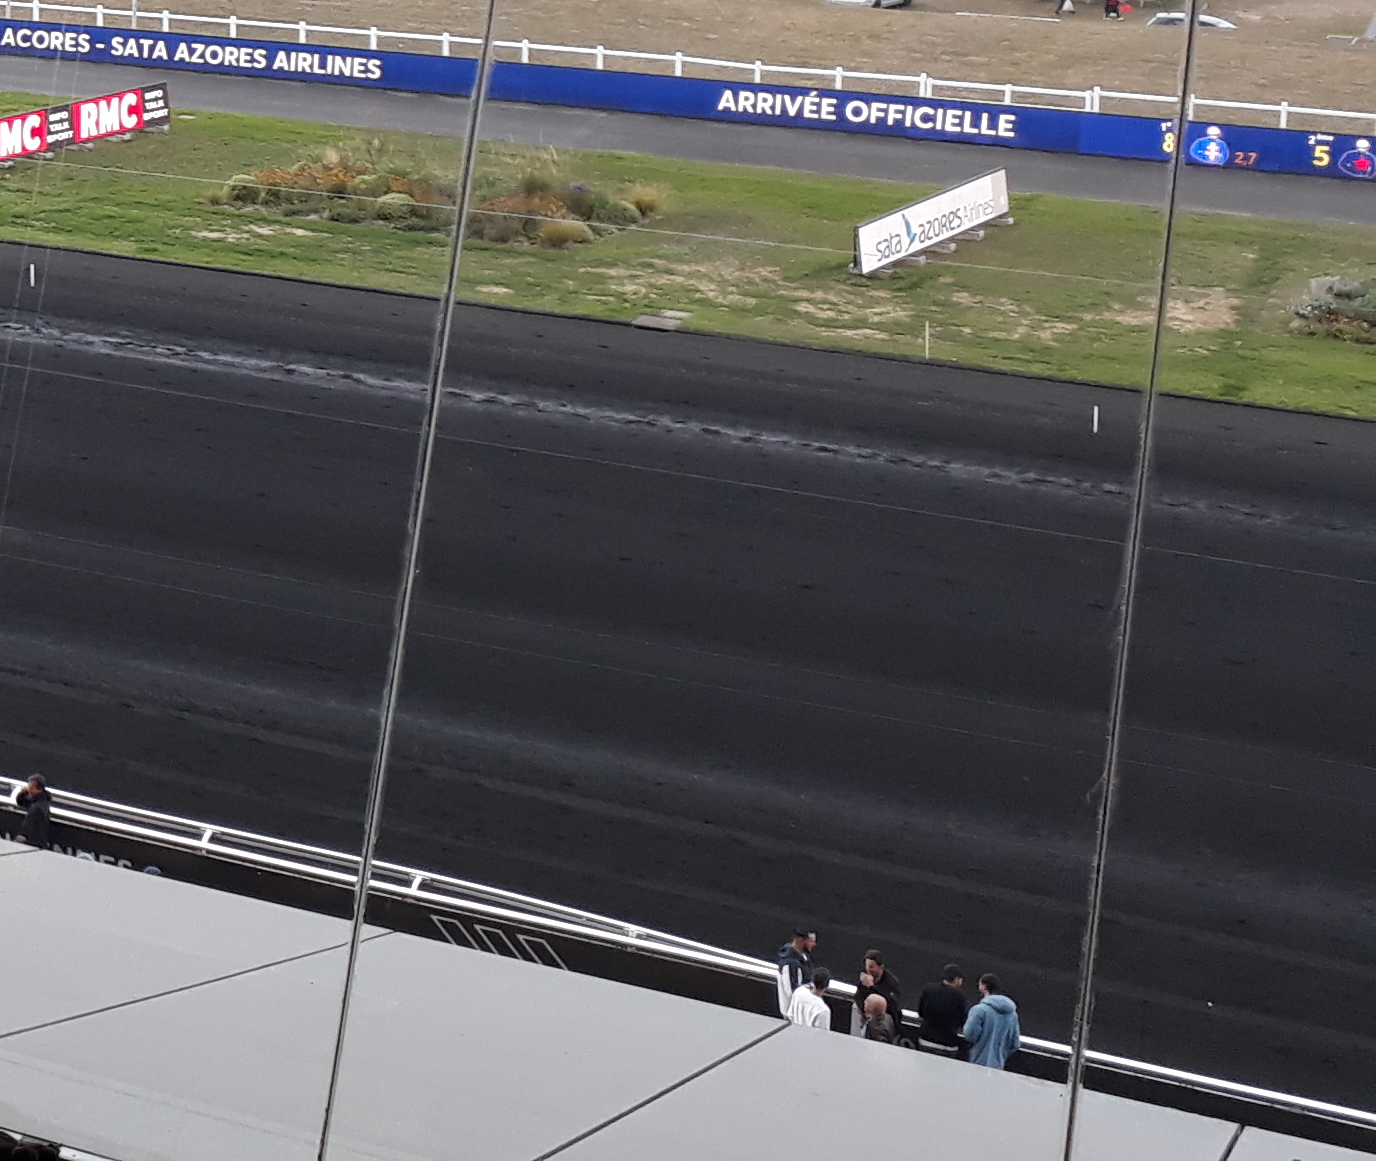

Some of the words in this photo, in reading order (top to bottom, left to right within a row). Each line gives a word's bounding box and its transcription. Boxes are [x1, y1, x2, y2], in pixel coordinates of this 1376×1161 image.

[0, 28, 91, 53] ACORES
[110, 37, 169, 60] SATA
[174, 42, 267, 69] AZORES
[272, 51, 382, 79] AIRLINES
[144, 89, 163, 100] INFO
[48, 111, 68, 122] INFO
[80, 92, 138, 139] RMC
[143, 109, 169, 121] SPORT
[717, 89, 837, 121] ARRIVÉE
[845, 100, 1017, 138] OFFICIELLE
[46, 130, 74, 144] SPORT
[1162, 132, 1175, 153] 8
[1312, 145, 1331, 167] 5
[876, 232, 903, 262] sata
[963, 197, 994, 226] Airlines
